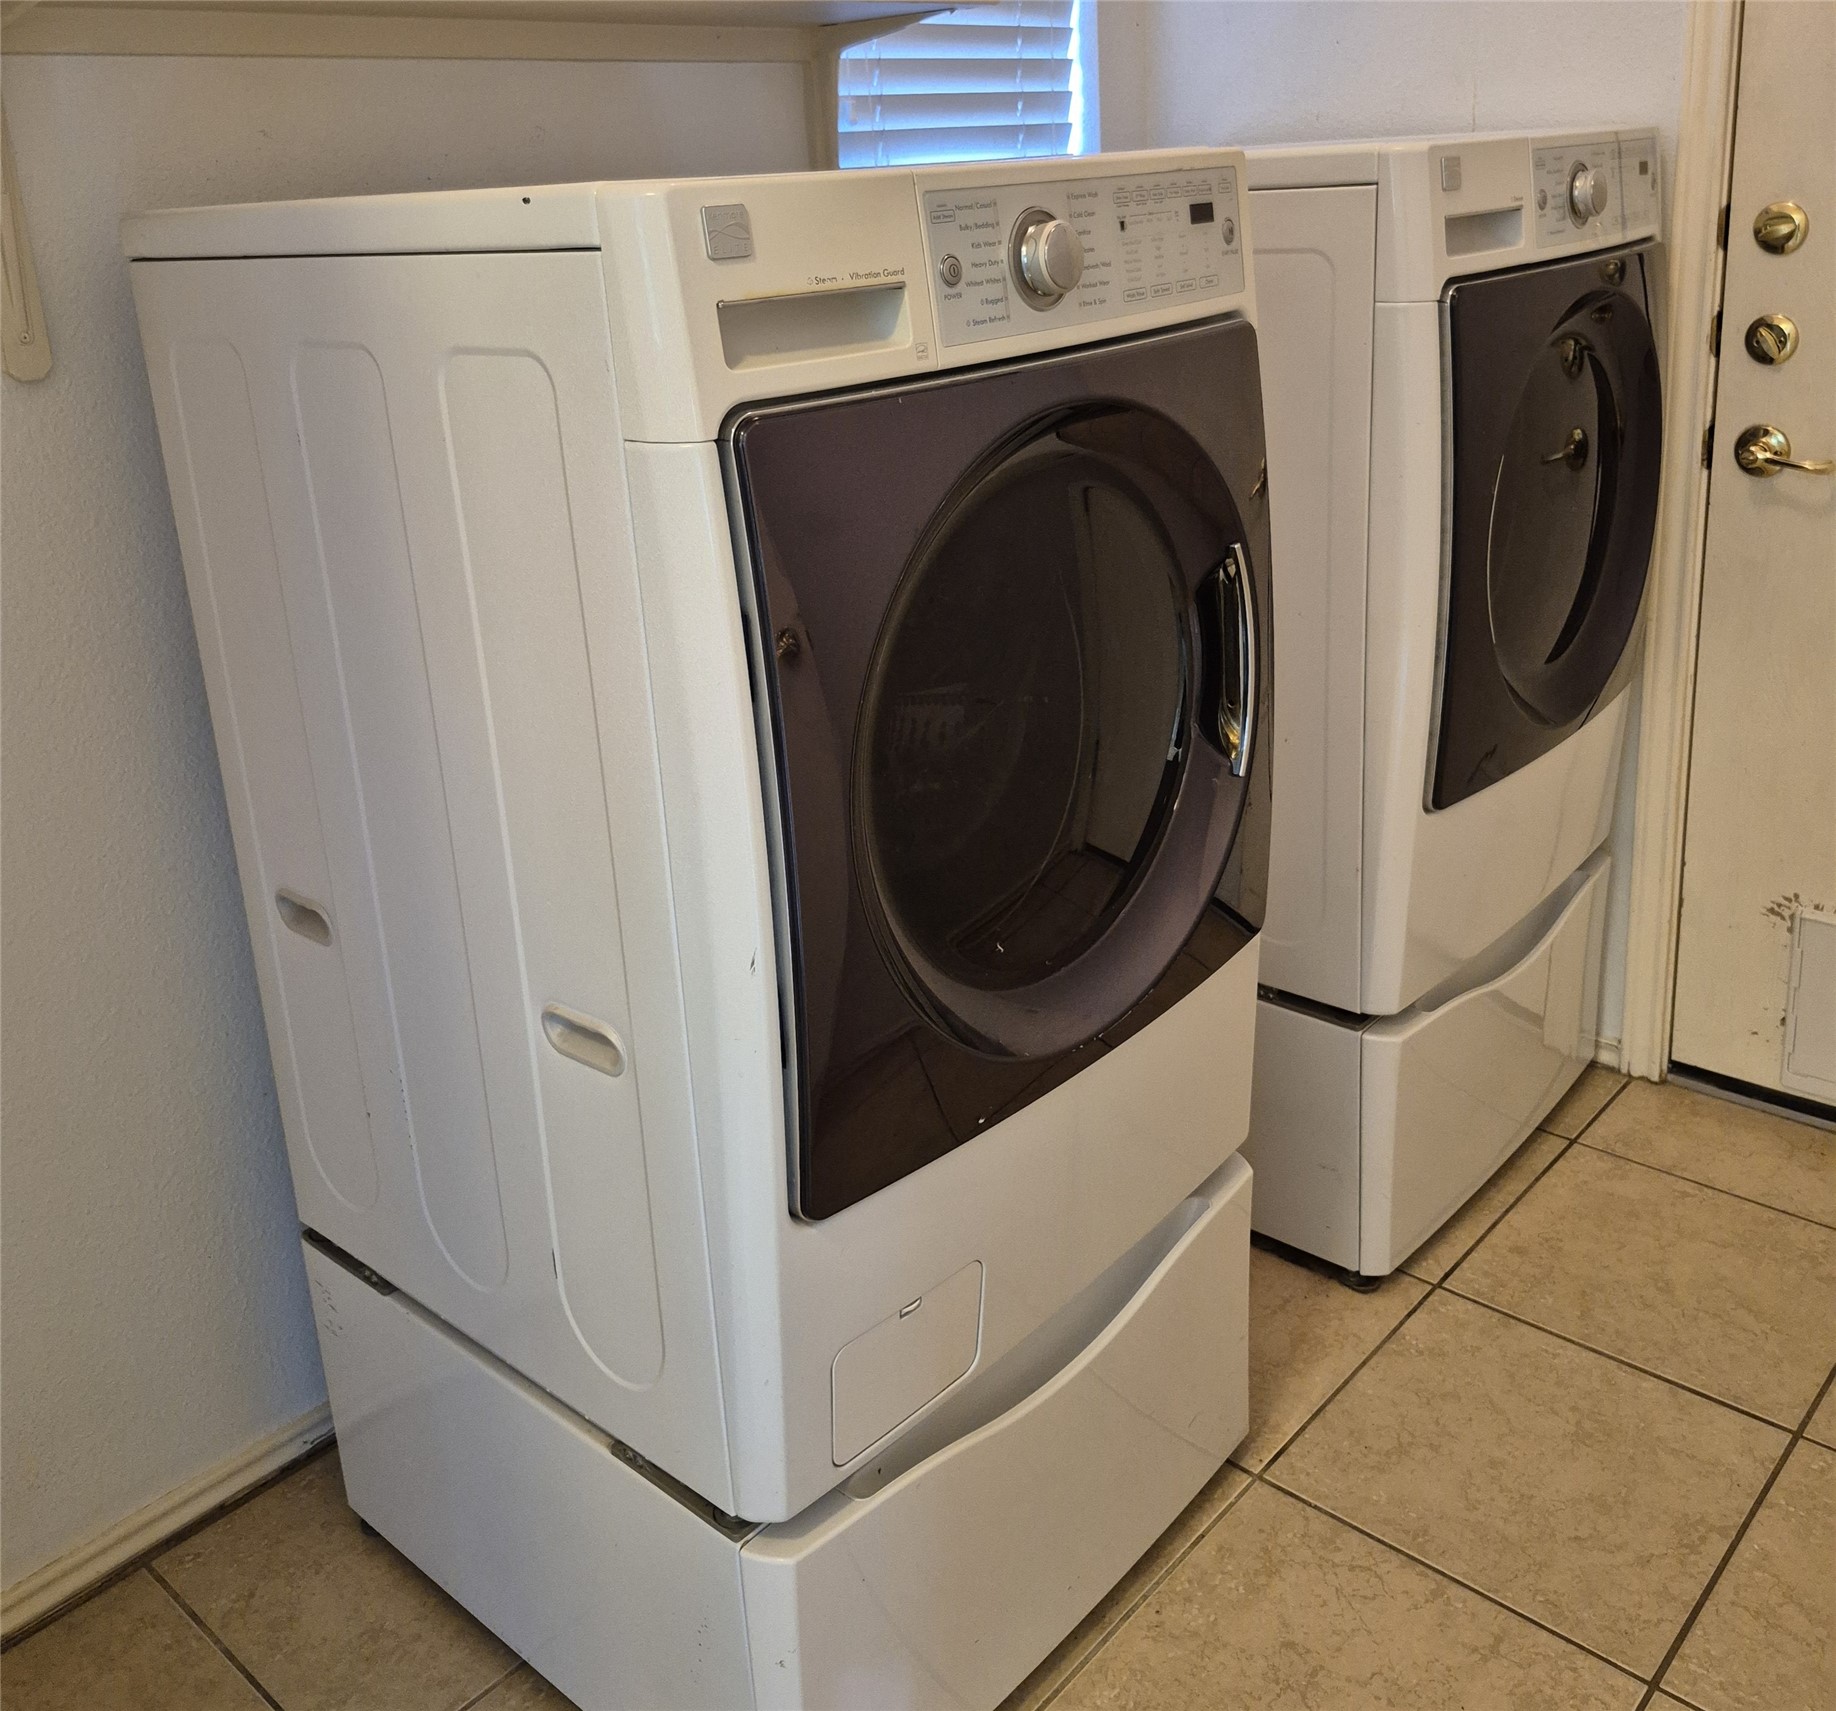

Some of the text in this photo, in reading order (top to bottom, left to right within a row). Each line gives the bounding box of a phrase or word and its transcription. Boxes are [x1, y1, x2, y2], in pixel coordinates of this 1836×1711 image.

[971, 259, 1000, 269] Heavy Duty
[848, 272, 881, 280] Vibration
[882, 267, 905, 278] Guard
